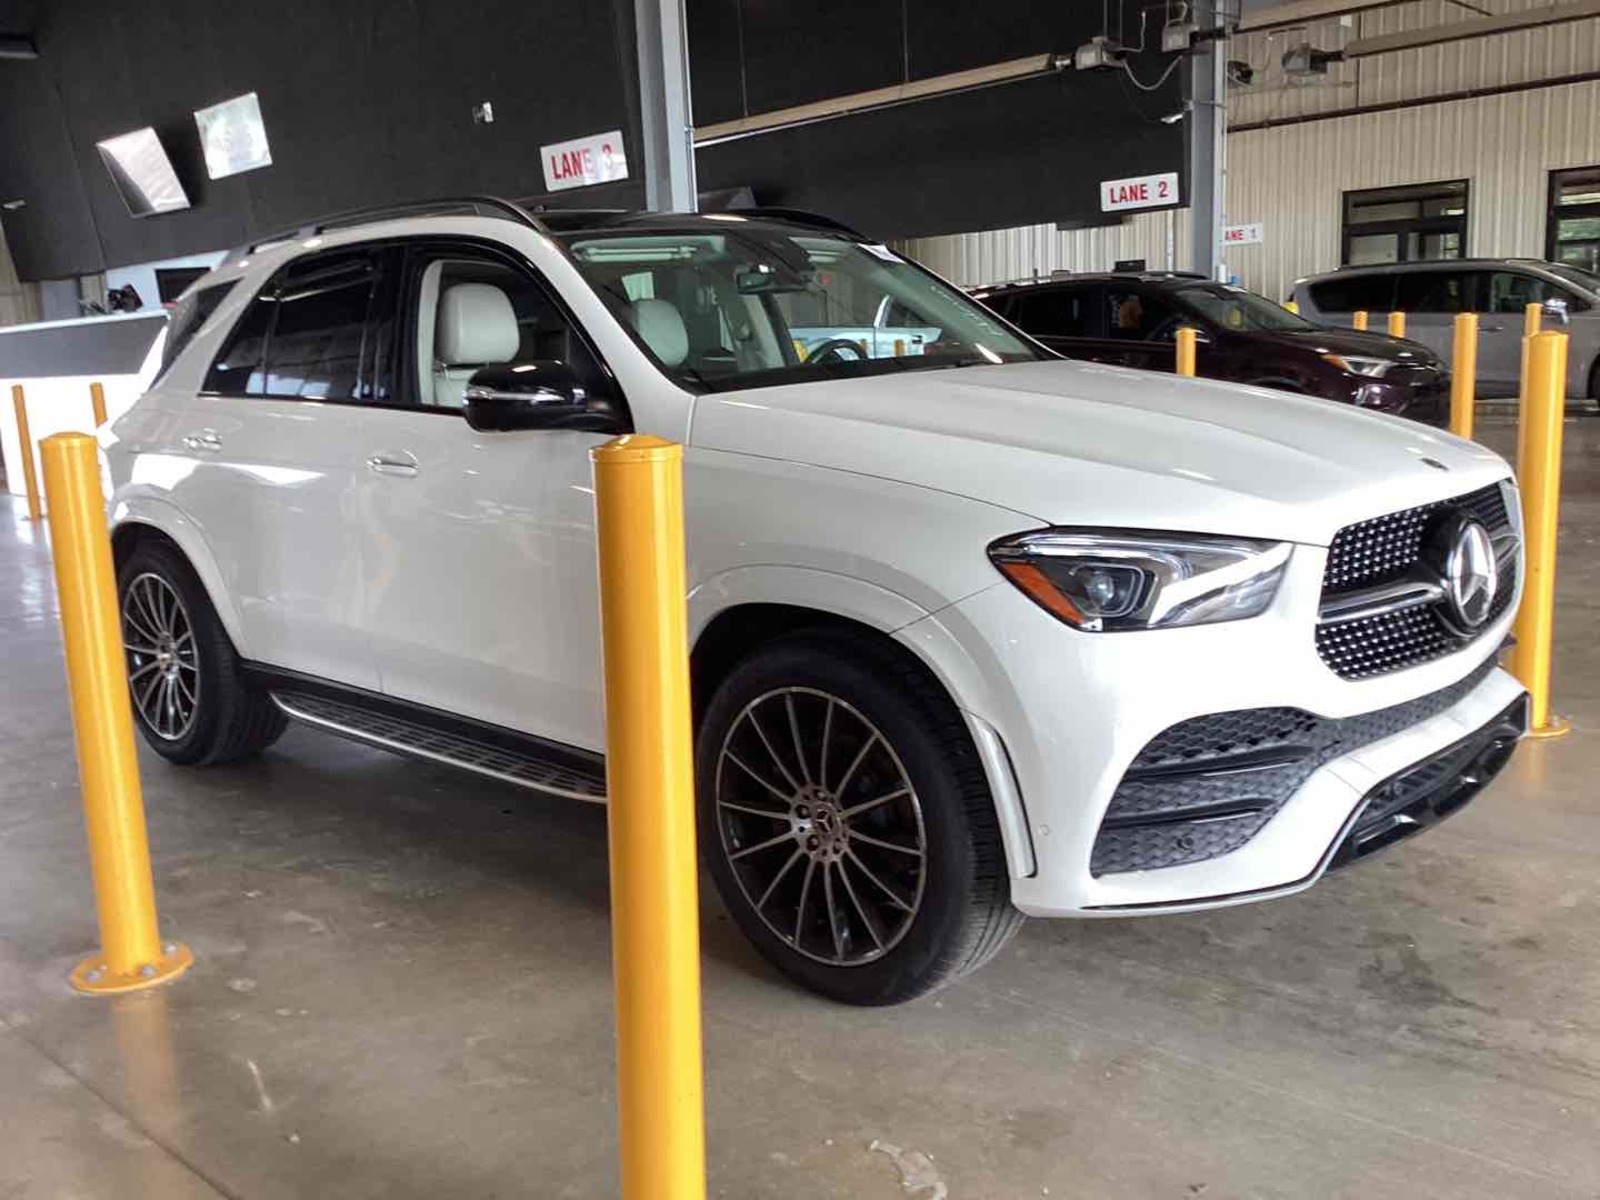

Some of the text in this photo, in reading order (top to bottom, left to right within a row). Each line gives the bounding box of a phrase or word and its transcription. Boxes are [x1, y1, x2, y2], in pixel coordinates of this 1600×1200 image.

[551, 143, 614, 180] LANE 3
[1110, 181, 1169, 204] LANE 2
[1225, 229, 1245, 241] ANE
